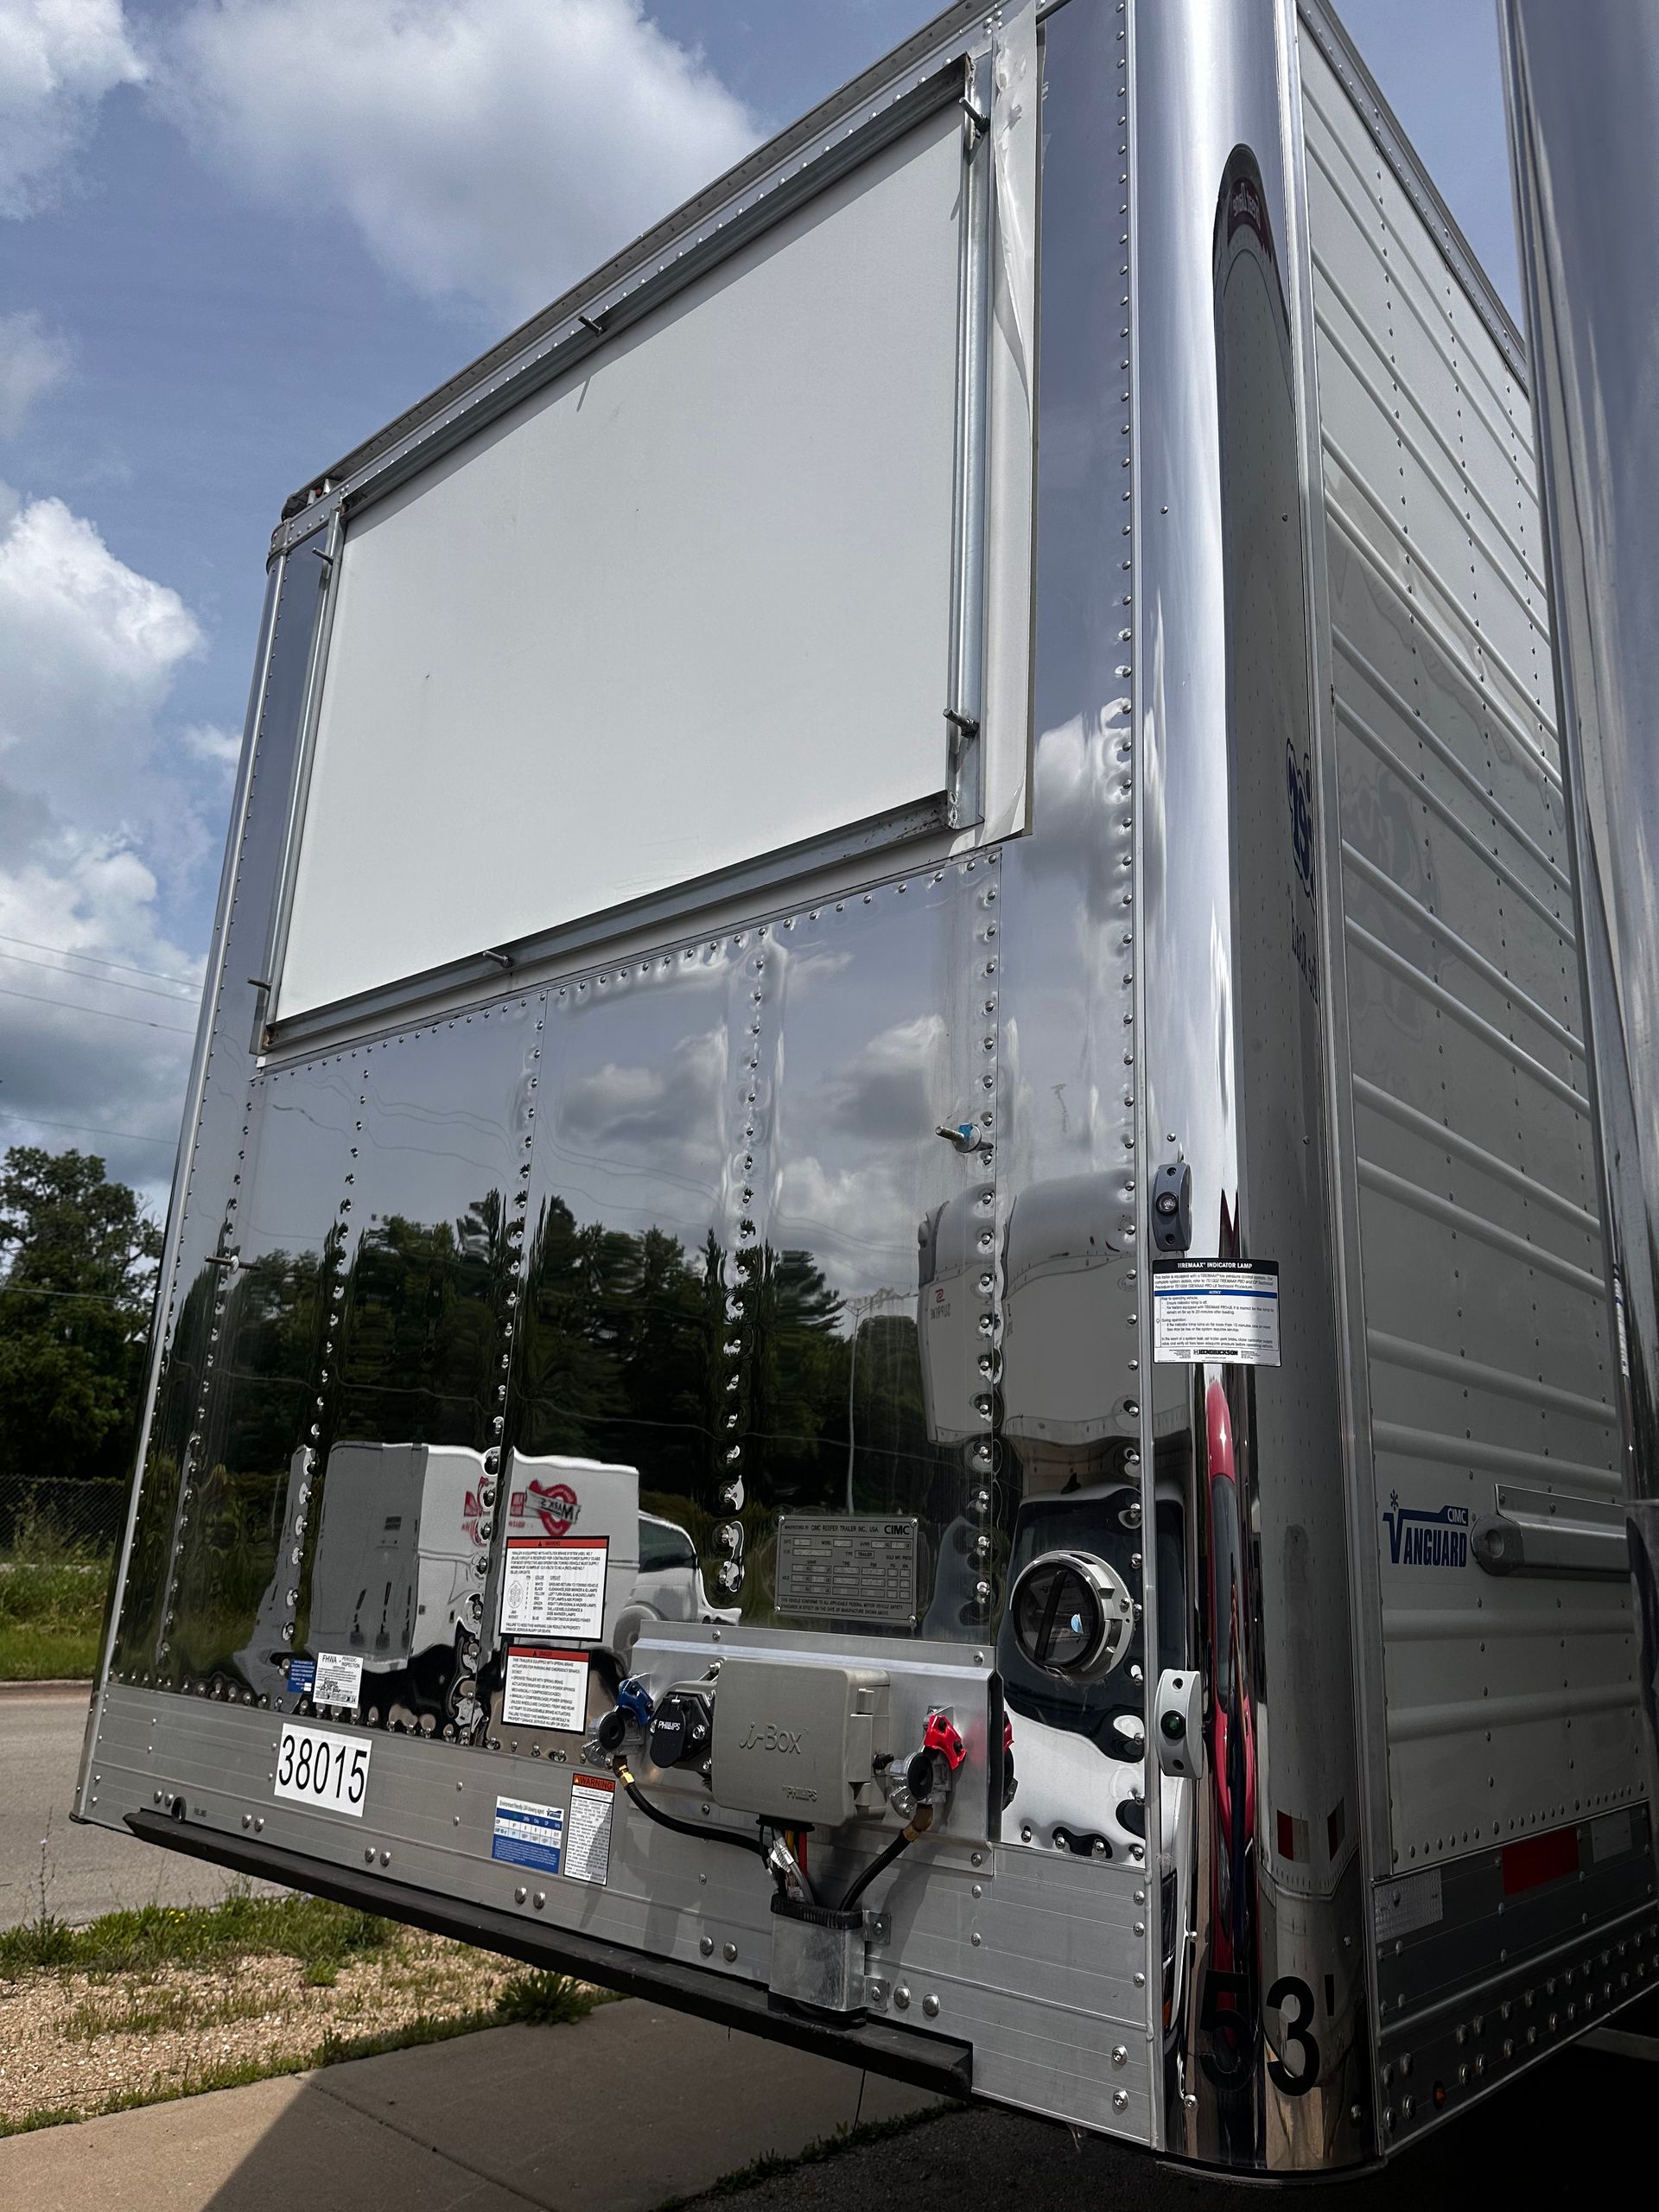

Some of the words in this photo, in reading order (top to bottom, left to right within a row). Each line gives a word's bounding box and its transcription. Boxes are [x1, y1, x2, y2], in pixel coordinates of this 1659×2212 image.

[1447, 1508, 1467, 1524] CIMC
[884, 1525, 910, 1535] CIMC
[1382, 1509, 1468, 1567] VANGUARD
[322, 1655, 337, 1664] FHWA
[279, 1735, 367, 1803] 38015
[580, 1777, 612, 1790] WARNING
